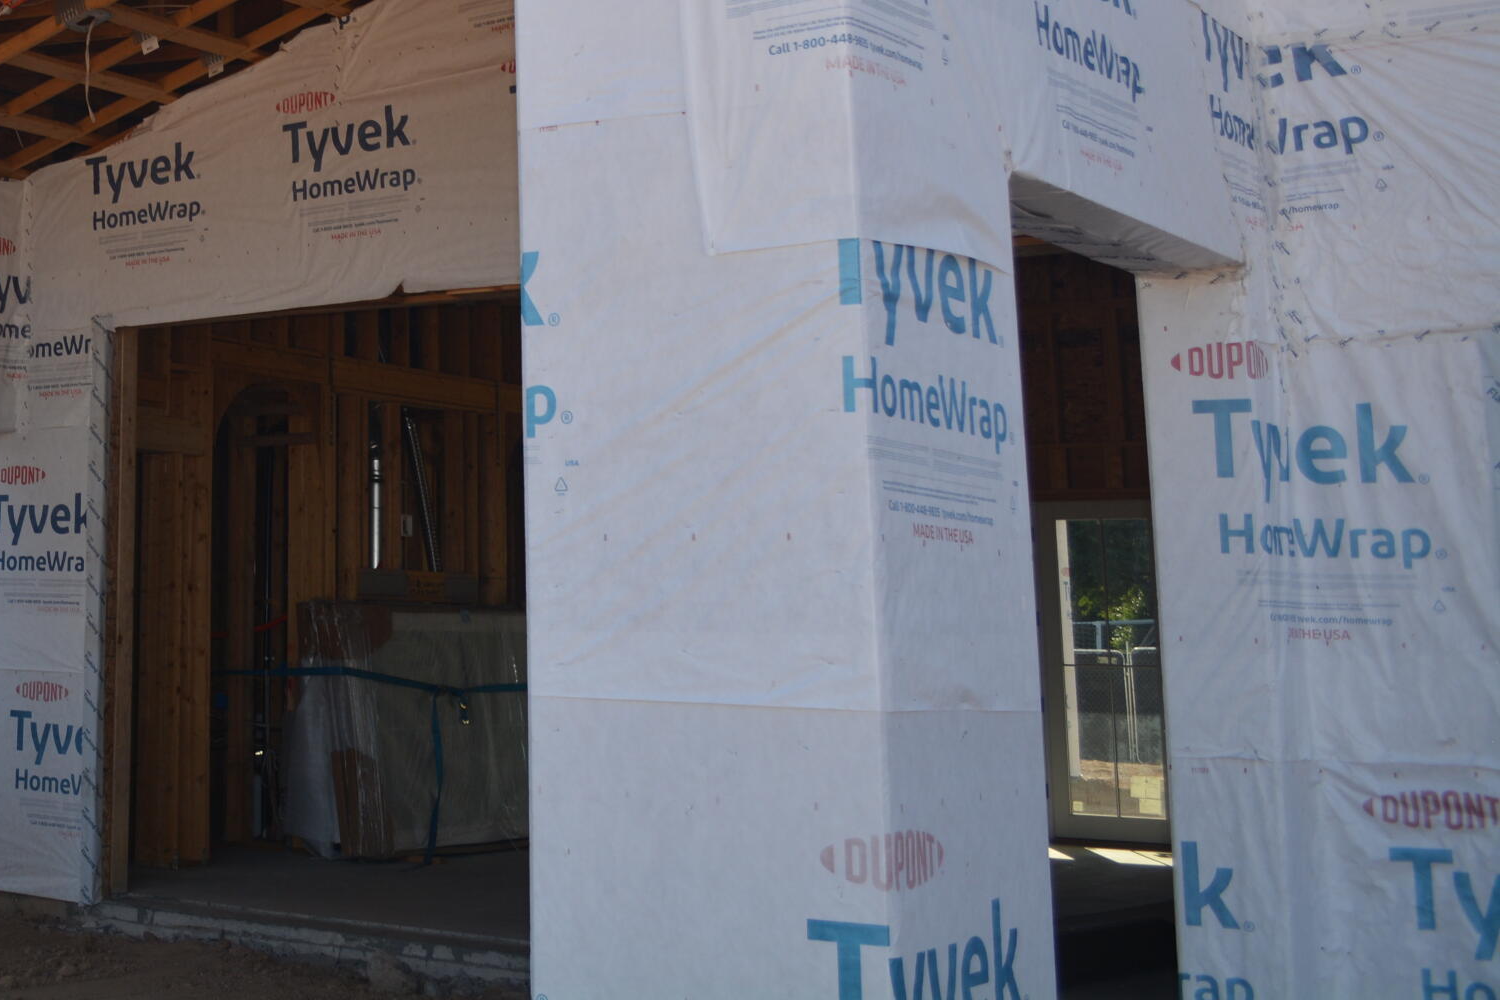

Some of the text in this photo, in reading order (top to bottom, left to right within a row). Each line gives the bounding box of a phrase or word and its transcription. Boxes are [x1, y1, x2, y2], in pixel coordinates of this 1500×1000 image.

[768, 43, 790, 56] Call
[282, 91, 330, 113] DUPONT
[282, 105, 410, 172] Tyvek
[85, 142, 195, 204] Tyvek
[292, 165, 416, 203] HomeWrap
[92, 199, 201, 232] HomeWrap
[841, 355, 1007, 455] HomeWrap
[1, 466, 41, 485] DUPONT
[913, 522, 934, 539] MADE
[944, 527, 958, 543] THE
[959, 530, 974, 544] USA
[22, 681, 63, 702] DUPONT
[844, 829, 935, 892] DUPONT
